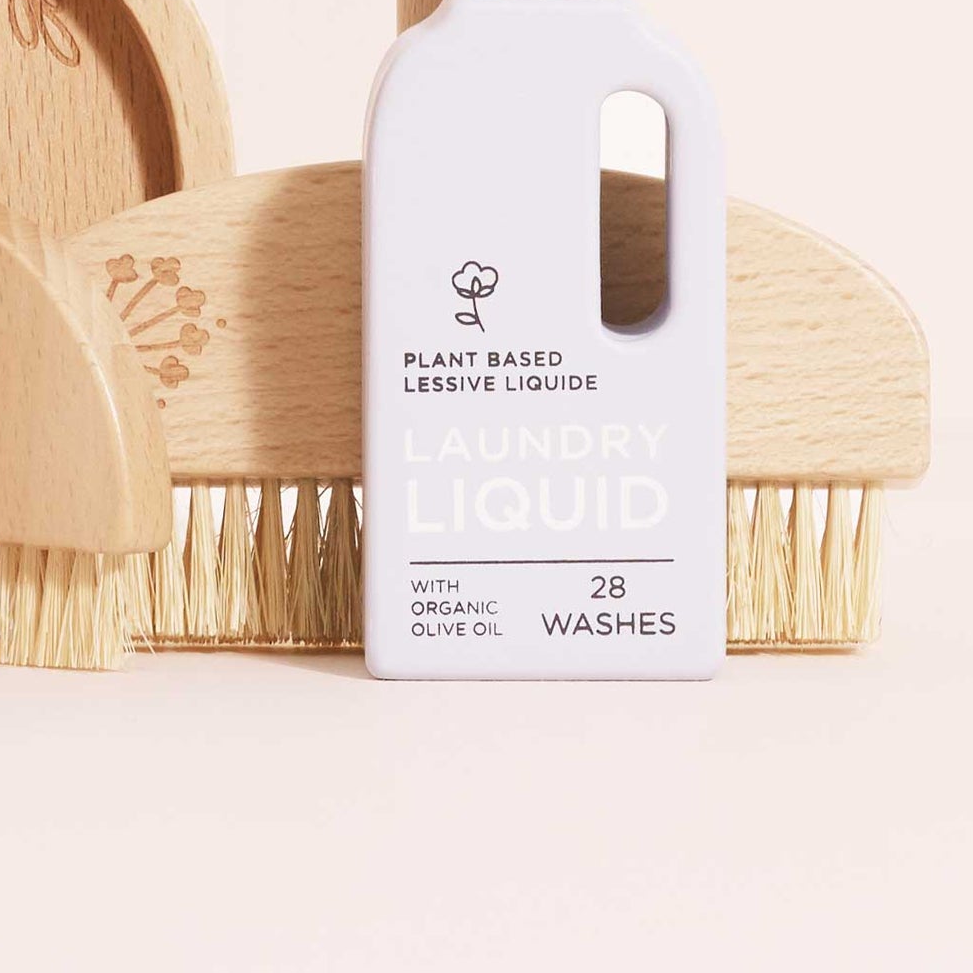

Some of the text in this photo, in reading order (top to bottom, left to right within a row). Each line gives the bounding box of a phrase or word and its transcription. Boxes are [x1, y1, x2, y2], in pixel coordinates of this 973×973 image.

[404, 351, 563, 368] PLANT BASED
[404, 374, 598, 393] LESSIVE LIQUIDE
[404, 424, 669, 463] LAUNDRY
[406, 475, 670, 534] LIQUID
[410, 579, 459, 594] WITH
[590, 575, 627, 600] 28
[411, 600, 499, 616] ORGANIC
[411, 621, 503, 637] OLIVE OIL
[541, 612, 677, 636] WASHES
